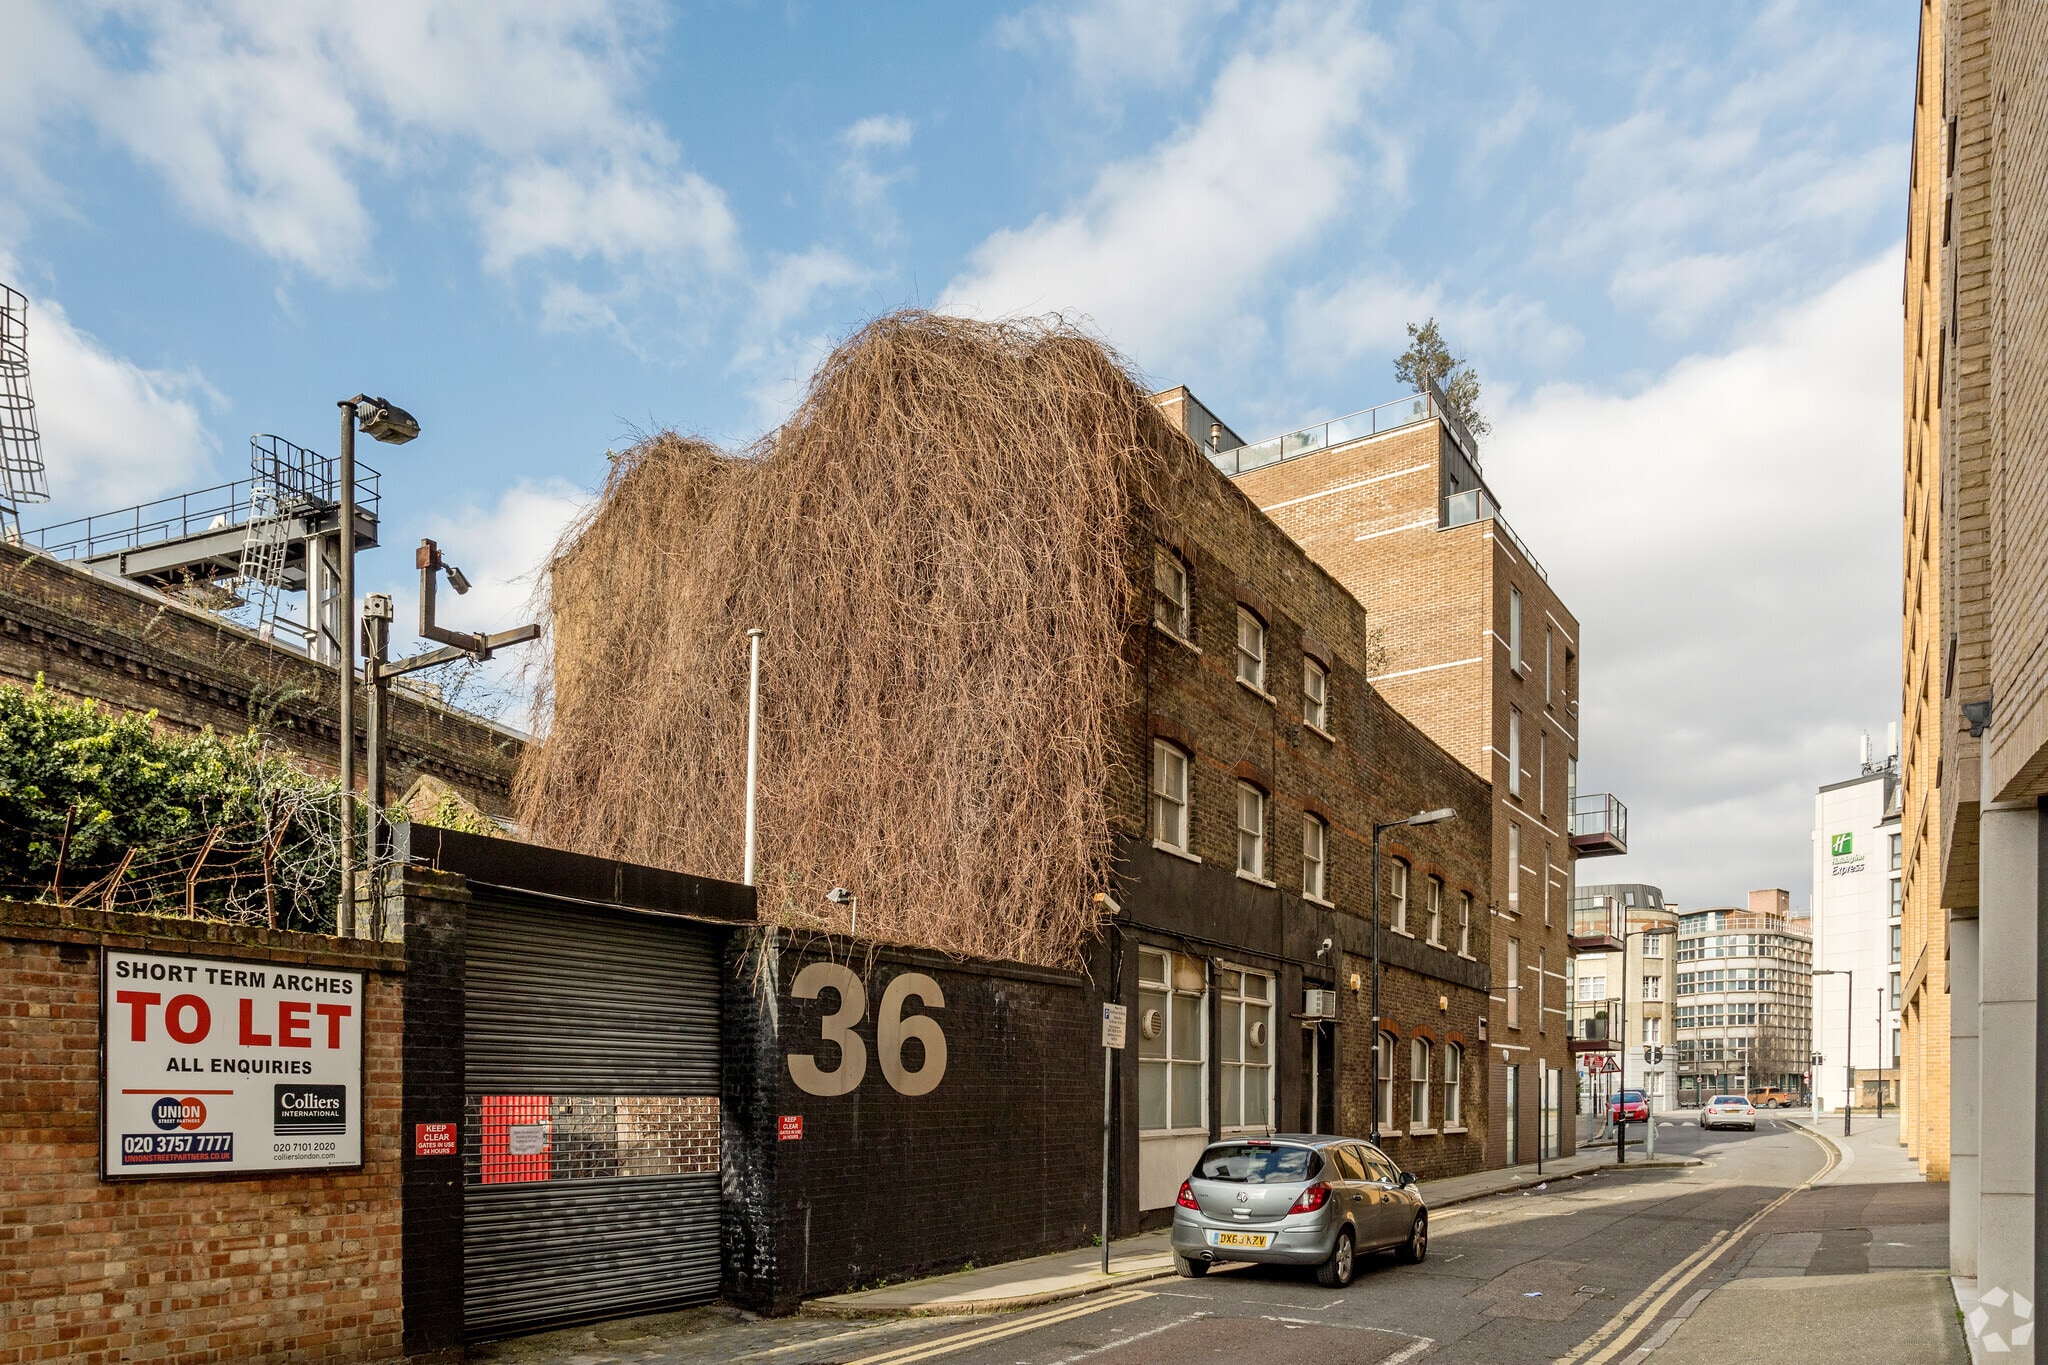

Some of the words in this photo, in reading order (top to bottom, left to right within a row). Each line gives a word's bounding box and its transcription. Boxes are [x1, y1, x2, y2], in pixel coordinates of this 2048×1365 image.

[1832, 864, 1864, 876] Express
[116, 960, 197, 983] SHORT
[205, 968, 265, 988] TERM
[272, 974, 353, 995] ARCHES
[116, 990, 212, 1045] TO
[239, 998, 352, 1049] LET
[787, 961, 948, 1097] 36
[166, 1057, 204, 1073] ALL
[210, 1058, 312, 1075] ENQUIRIES
[281, 1092, 340, 1109] Colliers
[158, 1105, 200, 1119] UNION
[124, 1137, 153, 1153] 020
[156, 1136, 193, 1153] 3757
[197, 1135, 231, 1152] 7777
[273, 1143, 291, 1152] 020
[293, 1142, 312, 1151] 7101
[313, 1142, 336, 1151] 2020
[125, 1152, 231, 1163] UNIONSTREETPARTNERS.CO.UK
[273, 1152, 336, 1161] collierslondon.com
